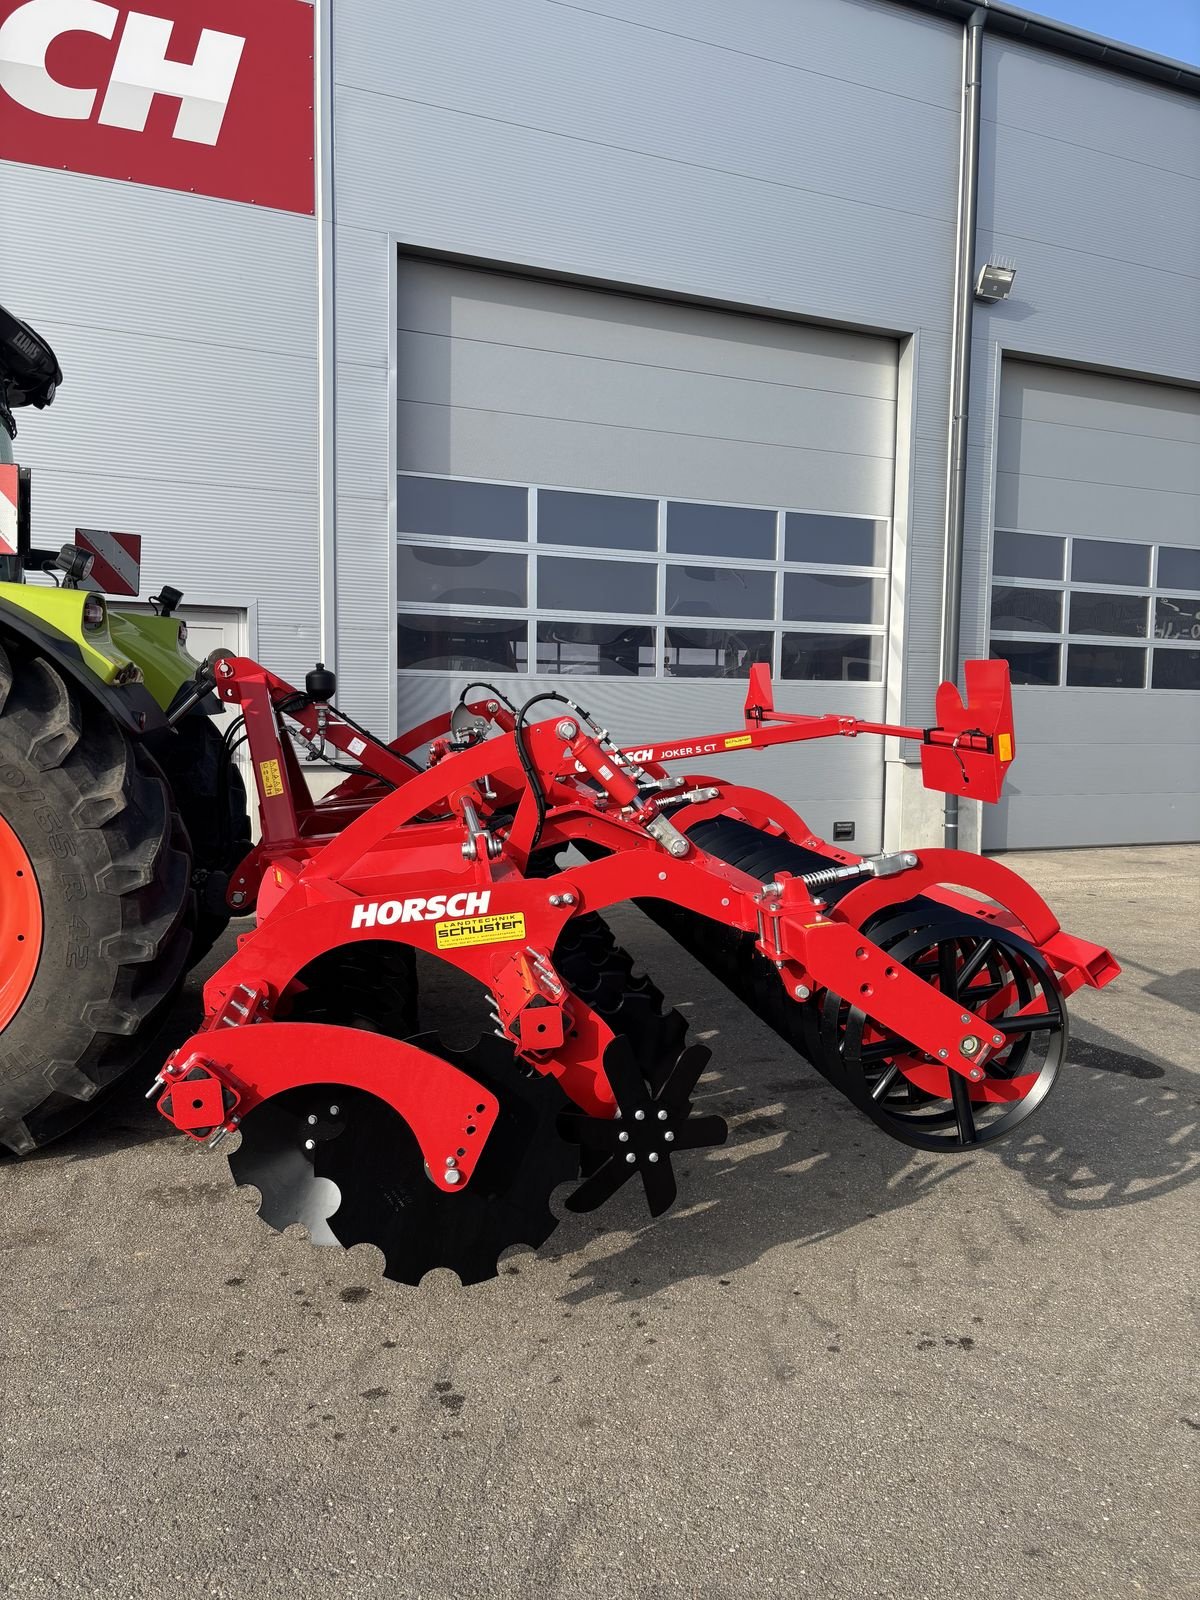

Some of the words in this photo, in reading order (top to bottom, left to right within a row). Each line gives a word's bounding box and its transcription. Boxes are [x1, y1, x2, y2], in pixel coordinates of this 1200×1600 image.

[0, 0, 246, 146] CH
[12, 331, 40, 359] CLAAS
[661, 747, 693, 759] JOKER
[695, 745, 702, 753] 5
[704, 743, 717, 752] CT
[351, 890, 491, 928] HORSCH
[438, 920, 523, 938] schuster
[444, 915, 516, 928] LANDTECHNIK
